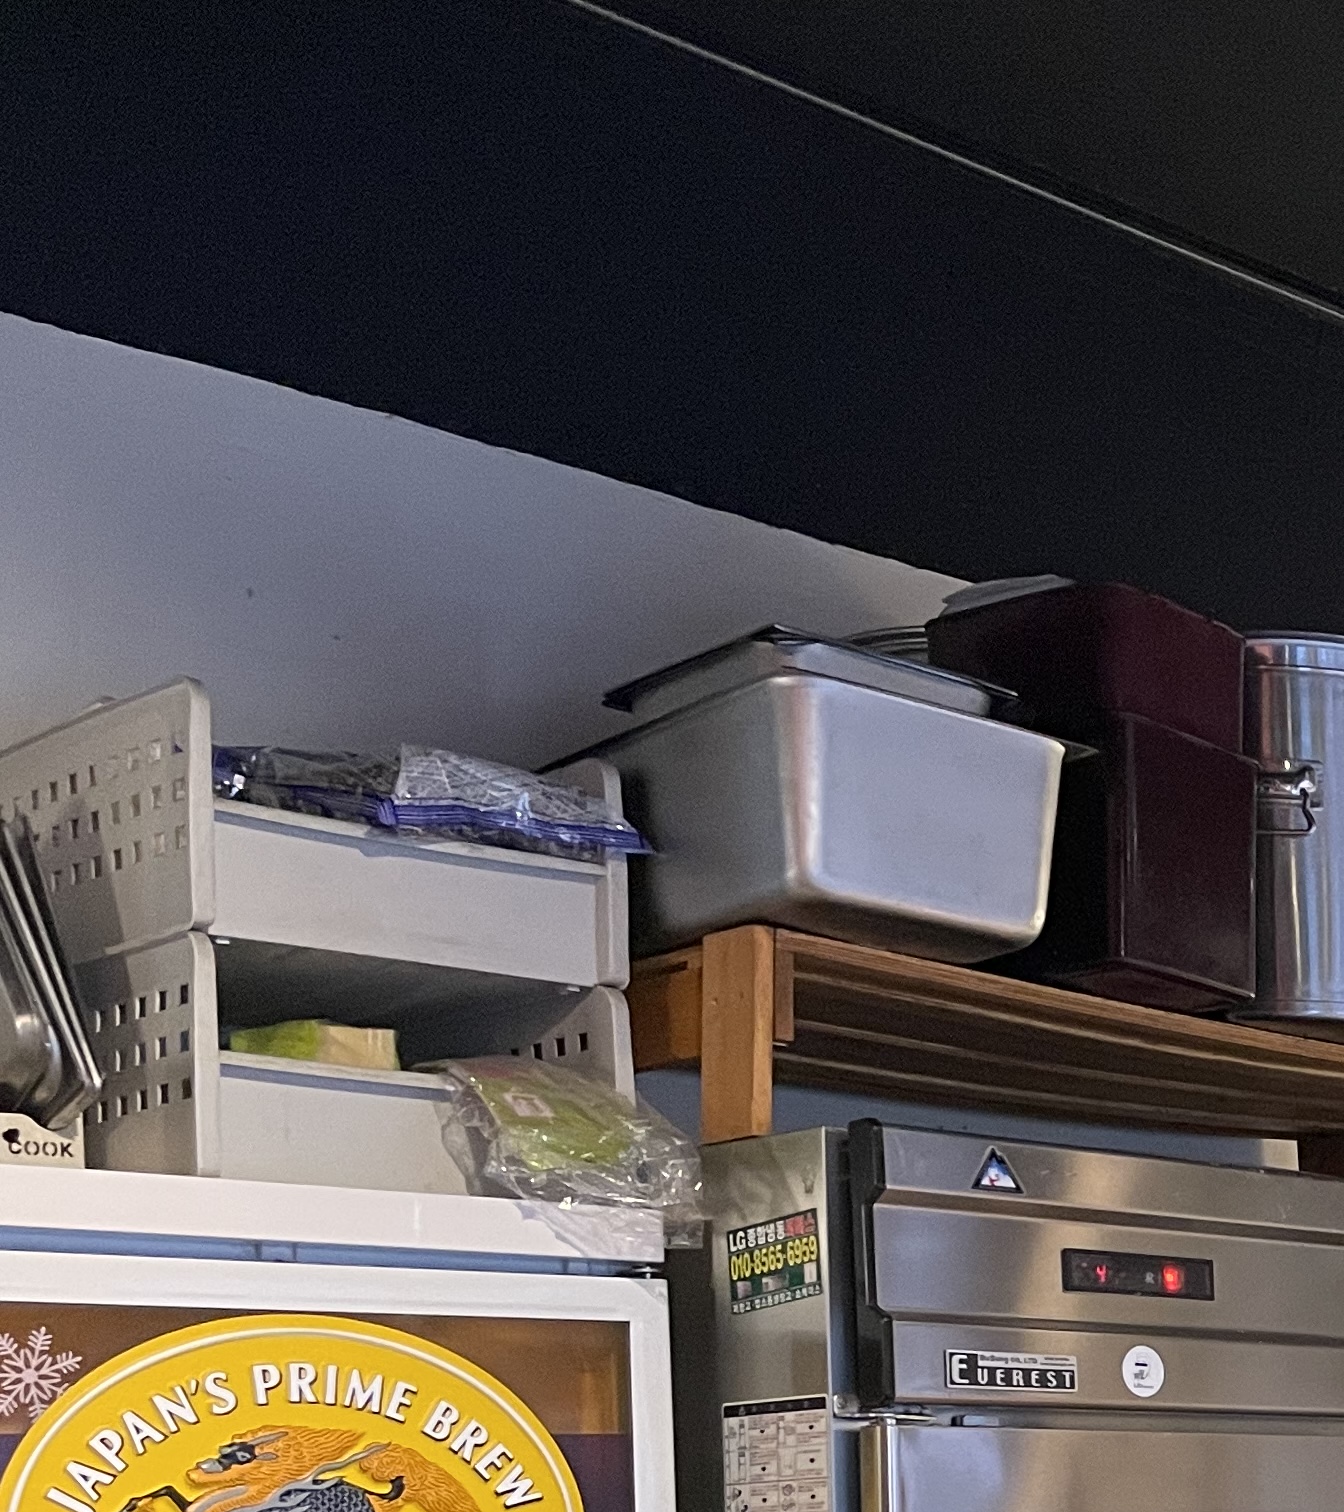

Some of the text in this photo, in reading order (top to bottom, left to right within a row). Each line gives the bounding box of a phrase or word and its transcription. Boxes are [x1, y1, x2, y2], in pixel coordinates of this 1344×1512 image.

[7, 1140, 75, 1158] COOK
[730, 1235, 819, 1281] 010-8565-6959
[950, 1354, 1075, 1388] EVEREST
[250, 1361, 419, 1425] PRIME
[421, 1400, 545, 1511] BREW
